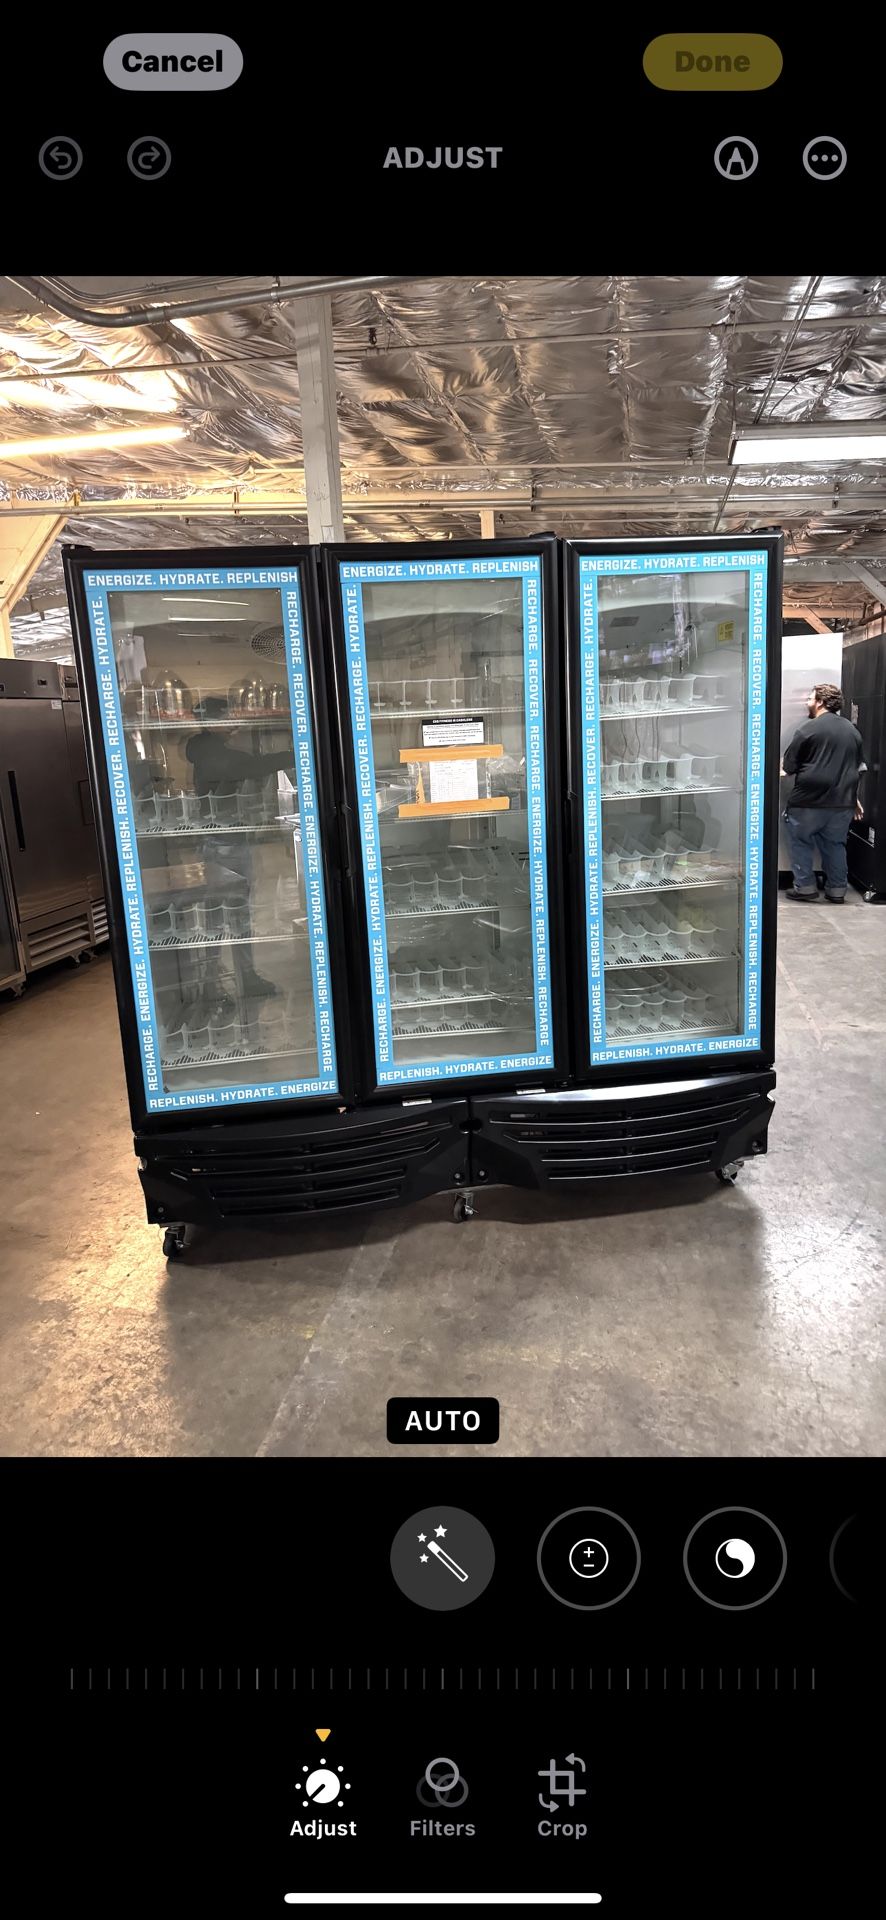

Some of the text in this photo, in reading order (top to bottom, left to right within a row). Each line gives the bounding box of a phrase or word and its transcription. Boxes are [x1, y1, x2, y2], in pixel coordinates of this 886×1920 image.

[88, 572, 296, 586] ENERGIZE. HYDRATE. REPLENISH
[343, 561, 538, 577] ENERGIZE. HYDRATE. REPLENISH
[582, 555, 765, 571] ENERGIZE. HYDRATE. REPLENISH
[93, 597, 157, 1090] RECHARGE. ENERGIZE. HYDRATE. REPLENISH. RECOVER. RECHARGE. HYDRATE.
[287, 592, 332, 1072] RECHARGE. RECOVER. RECHARGE. ENERGIZE. HYDRATE. REPLENISH. RECHARGE
[347, 585, 388, 1062] RECHARGE. ENERGIZE. HYDRATE. REPLENISH. RECOVER. RECHARGE. HYDRATE.
[527, 580, 549, 1045] RECHARGE. RECOVER. RECHARGE. ENERGIZE. HYDRATE. REPLENISH. RECHARGE
[583, 579, 602, 1043] RECHARGE. ENERGIZE. HYDRATE. REPLENISH. RECOVER. RECHARGE. HYDRATE.
[748, 573, 763, 1030] RECHARGE. RECOVER. RECHARGE. ENERGIZE. HYDRATE. REPLENISH. RECHARGE
[150, 1081, 336, 1107] REPLENISH. HYDRATE. ENERGIZE
[380, 1056, 551, 1080] REPLENISH. HYDRATE. ENERGIZE
[593, 1038, 758, 1060] REPLENISH. HYDRATE. ENERGIZE
